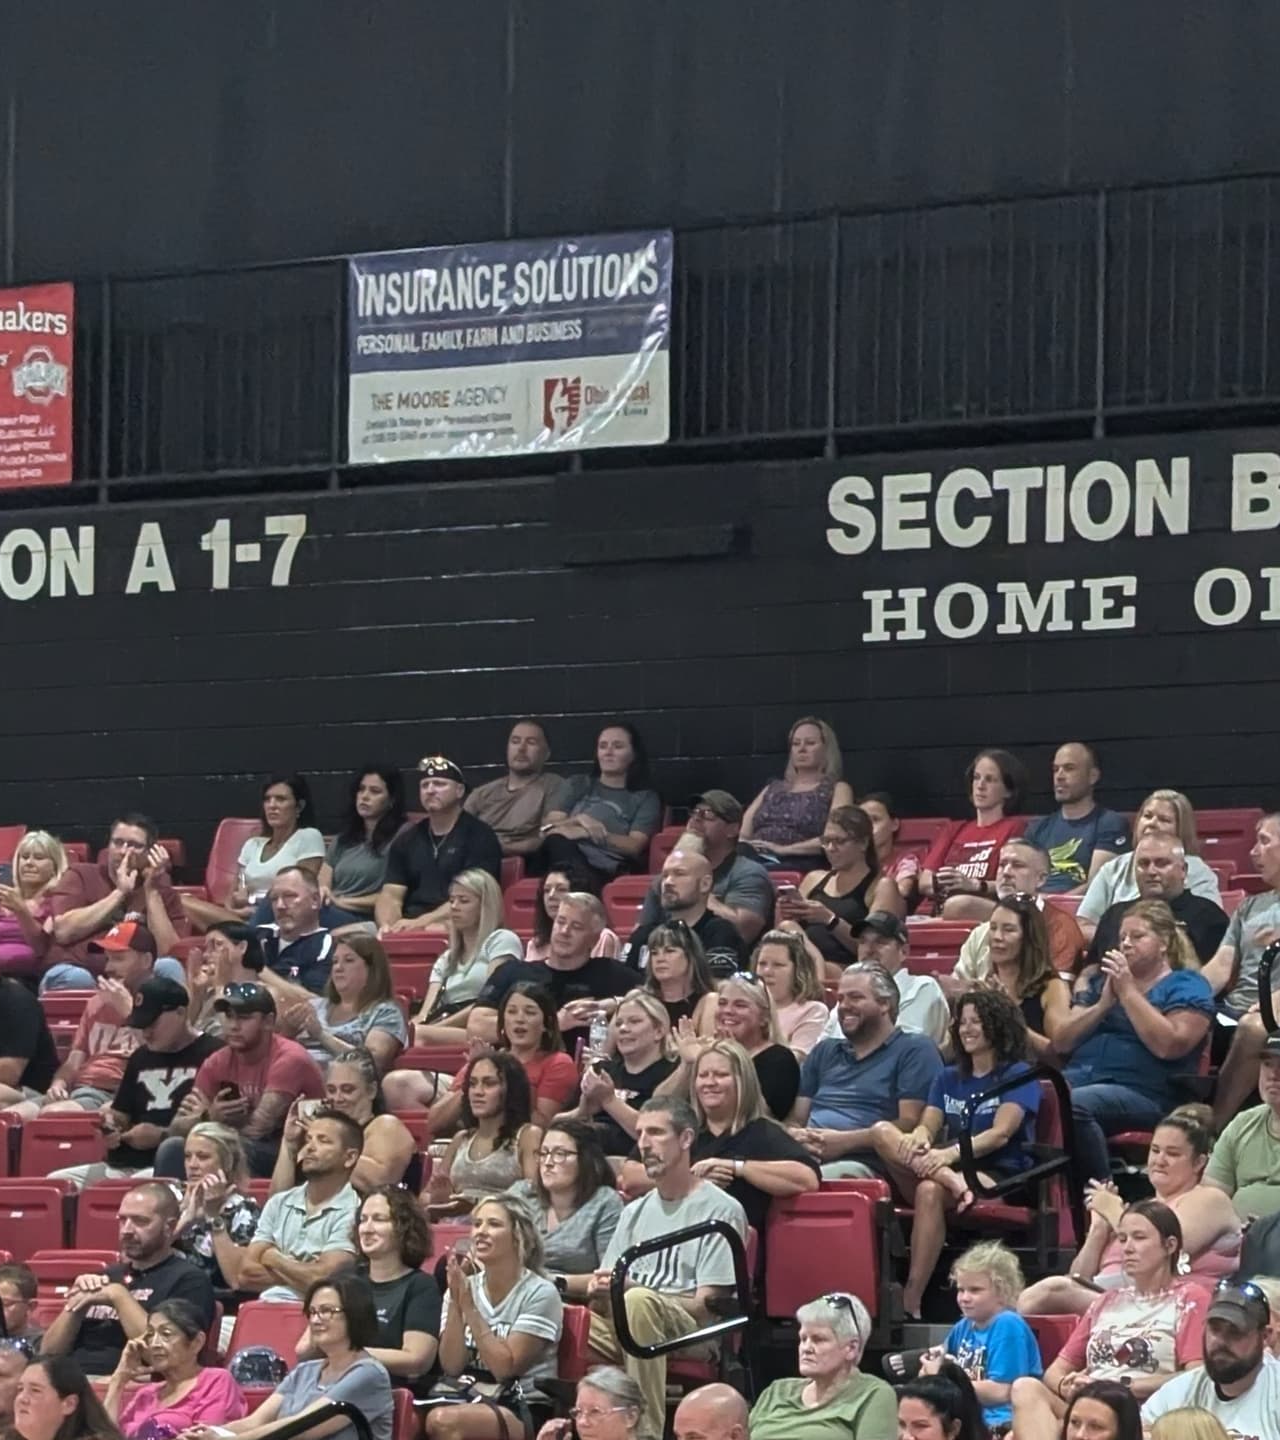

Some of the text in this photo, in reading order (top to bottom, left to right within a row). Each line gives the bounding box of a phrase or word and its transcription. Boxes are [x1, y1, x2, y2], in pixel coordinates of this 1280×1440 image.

[357, 251, 660, 317] INSURANCE SOLUTIONS
[466, 325, 498, 349] FARM
[501, 323, 524, 345] AND
[526, 319, 582, 341] BUSINESS
[371, 386, 509, 411] THE MOORE AGENCY
[825, 456, 1190, 555] SECTION
[124, 521, 177, 595] A
[200, 513, 307, 590] 1-7
[862, 575, 1138, 643] HOME
[136, 1068, 198, 1111] Y
